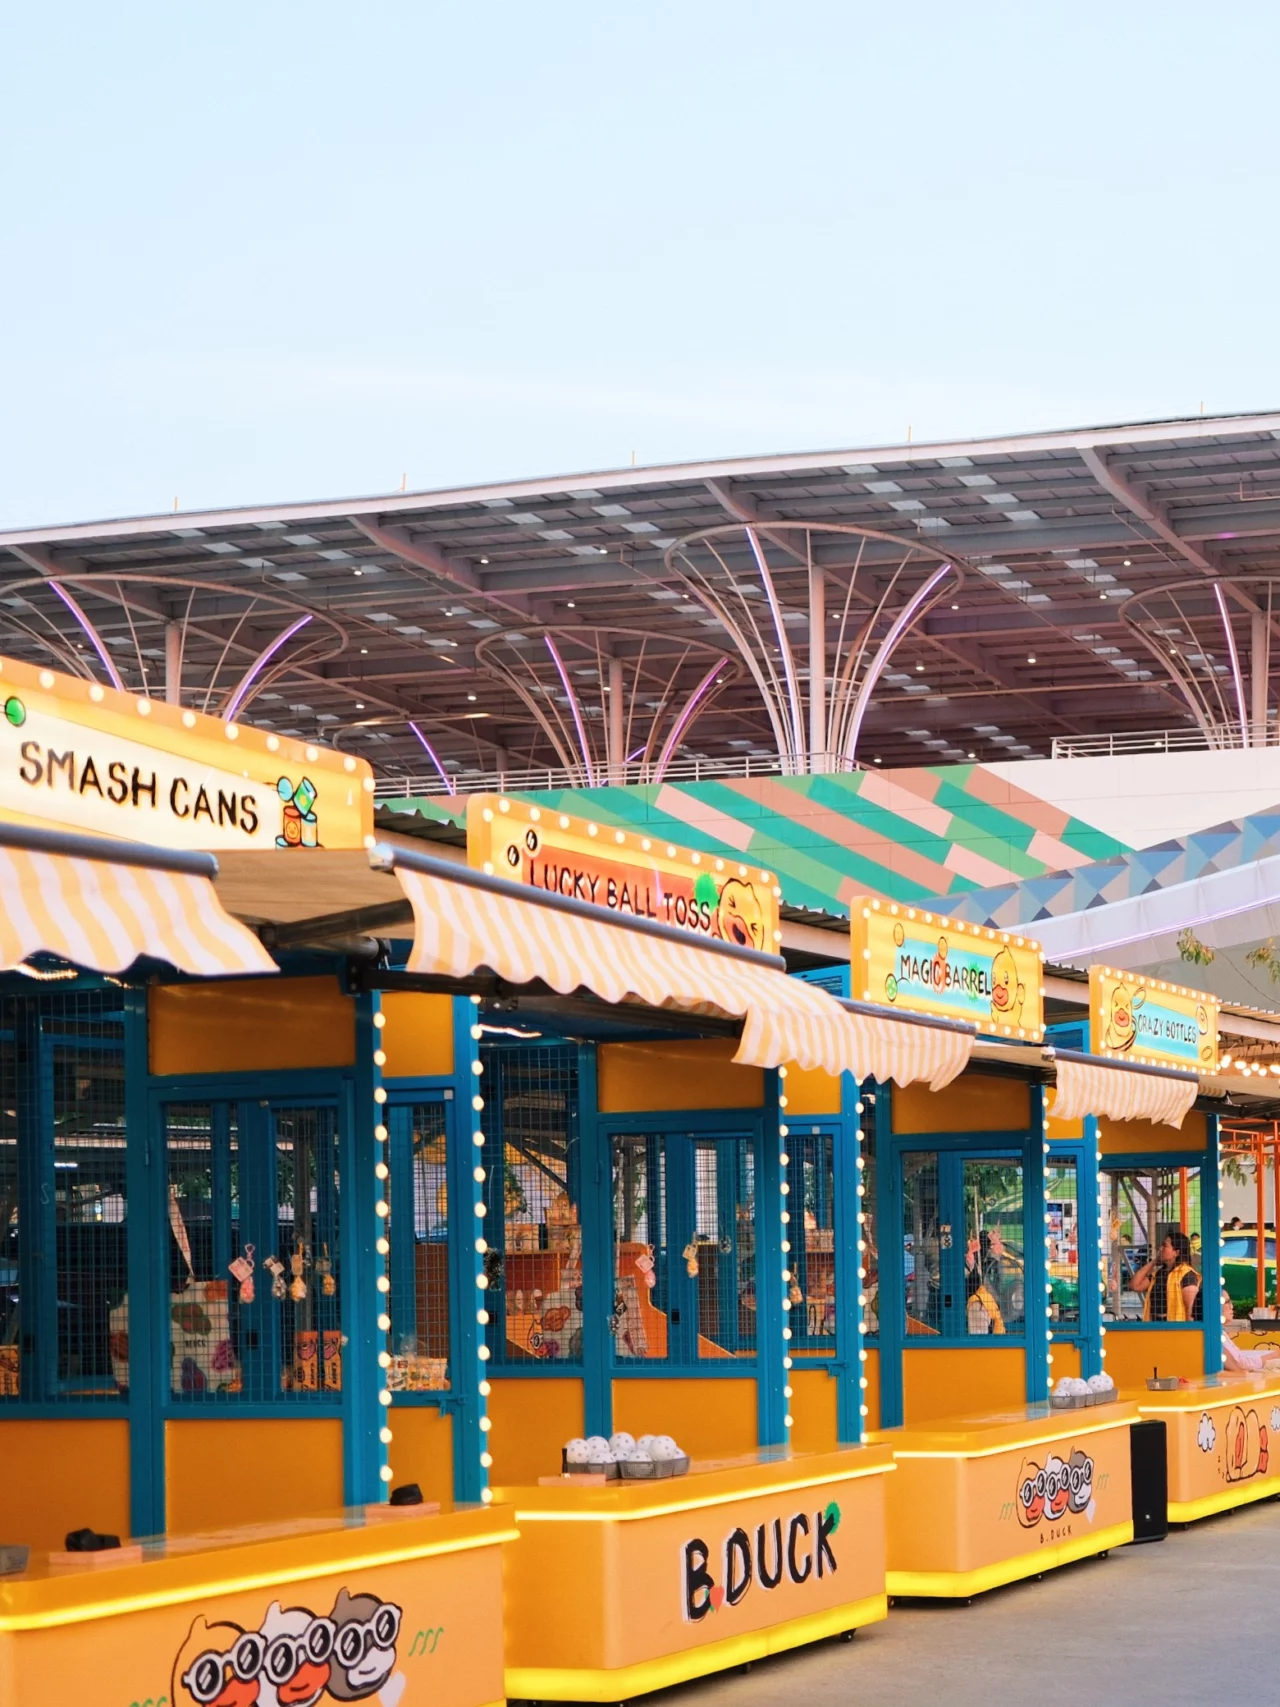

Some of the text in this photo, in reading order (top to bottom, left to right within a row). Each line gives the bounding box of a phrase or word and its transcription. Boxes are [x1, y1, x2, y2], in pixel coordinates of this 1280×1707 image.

[20, 741, 259, 834] SMASH CANS
[530, 859, 711, 931] LUCKY BALL TOSS
[900, 954, 992, 996] MAGIC BARREL
[1137, 1014, 1197, 1044] CRAZY BOTTLES
